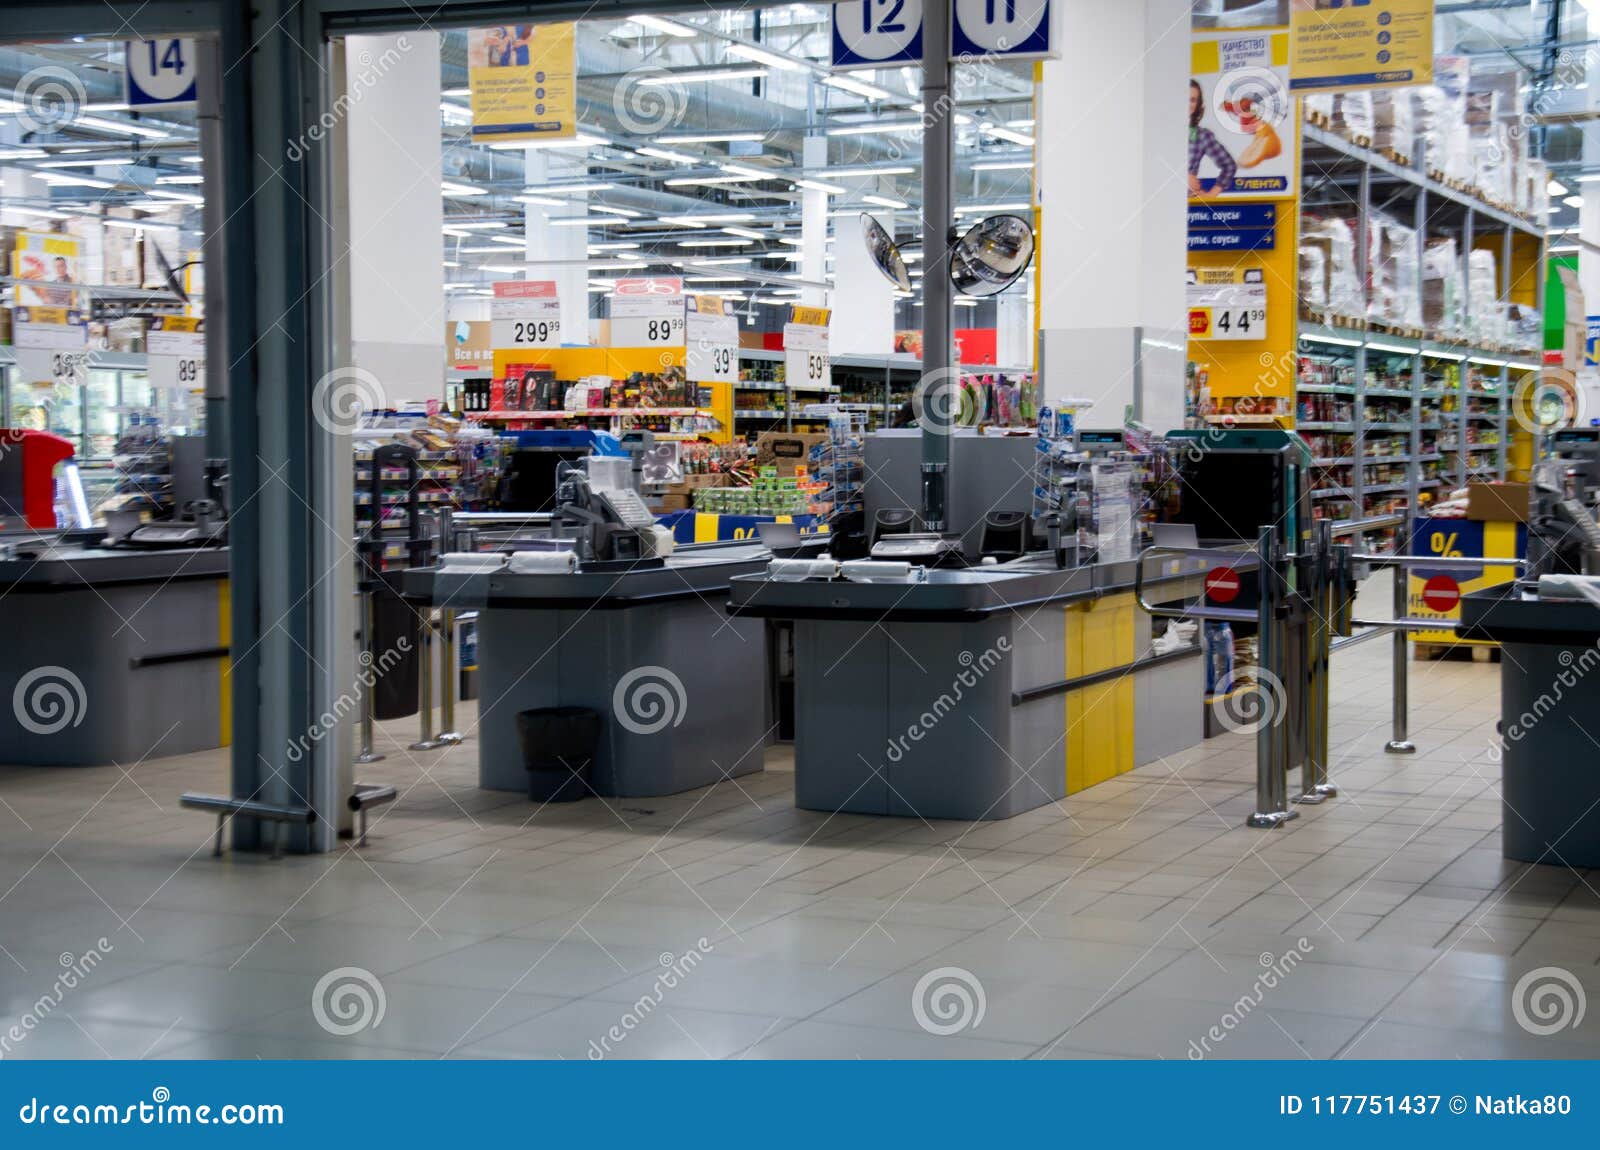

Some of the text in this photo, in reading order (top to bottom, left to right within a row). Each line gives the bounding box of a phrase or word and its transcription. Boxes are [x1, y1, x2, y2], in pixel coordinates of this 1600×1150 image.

[863, 0, 906, 34] 12
[143, 38, 185, 77] 14
[1212, 211, 1241, 223] соусы
[1212, 235, 1240, 247] соусы
[514, 322, 548, 343] 299
[648, 320, 671, 341] 89
[179, 359, 197, 382] 89
[713, 348, 729, 374] 39
[809, 355, 823, 379] 59
